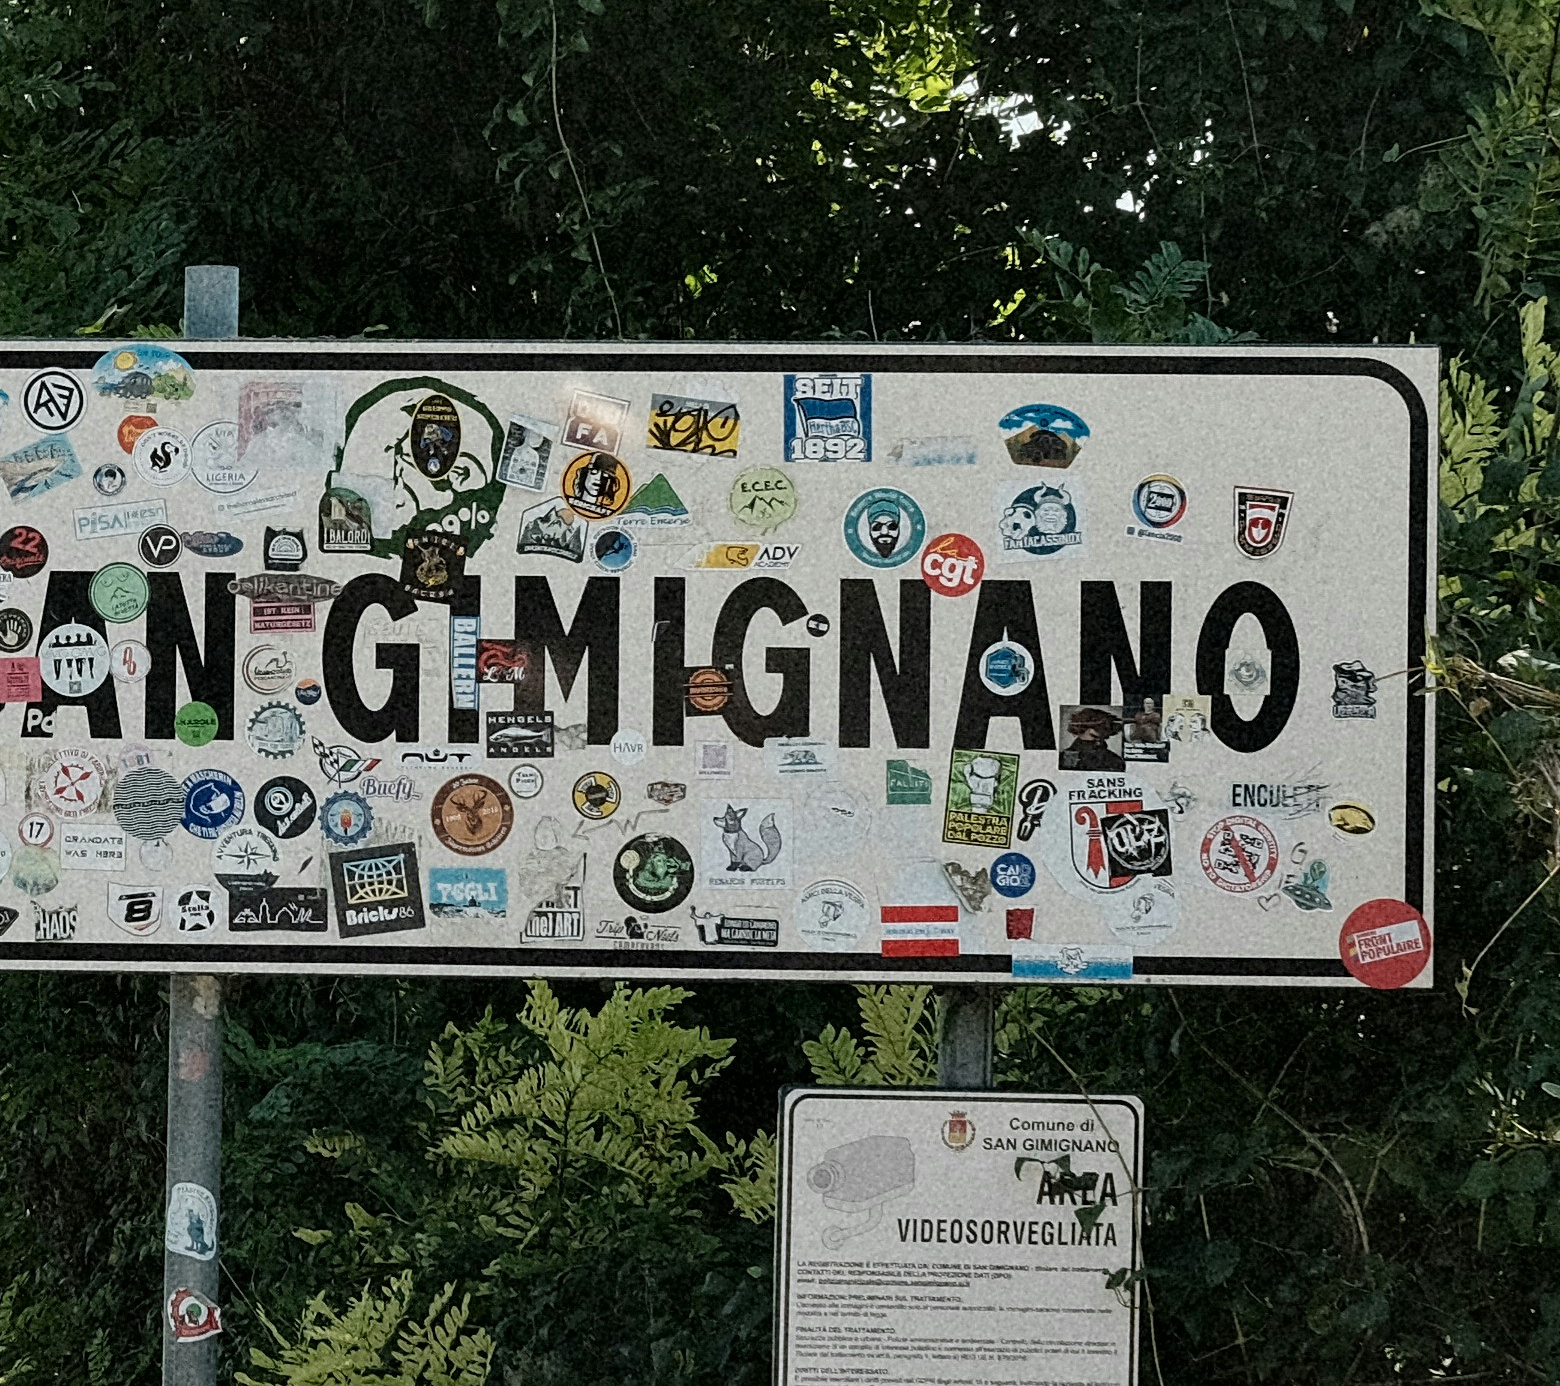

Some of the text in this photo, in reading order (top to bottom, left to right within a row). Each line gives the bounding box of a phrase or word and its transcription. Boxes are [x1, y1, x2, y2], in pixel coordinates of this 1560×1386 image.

[795, 377, 862, 400] SEIT
[790, 438, 867, 460] 1892
[923, 554, 978, 587] cgt
[488, 715, 552, 724] HENGELS
[1086, 778, 1126, 789] SANS
[1068, 788, 1143, 801] FRACKING
[948, 812, 1009, 826] PALESTRA
[1207, 821, 1226, 839] STOP
[1226, 815, 1258, 828] DIGITAL
[29, 821, 45, 839] 17
[946, 830, 1007, 844] DAL POZZO
[947, 822, 1008, 836] POPOLARE
[1358, 932, 1393, 951] FRONT
[1361, 939, 1423, 962] POPULAIRE
[1009, 1117, 1095, 1132] Comune di
[982, 1137, 1120, 1153] SAN GIMIGNANO
